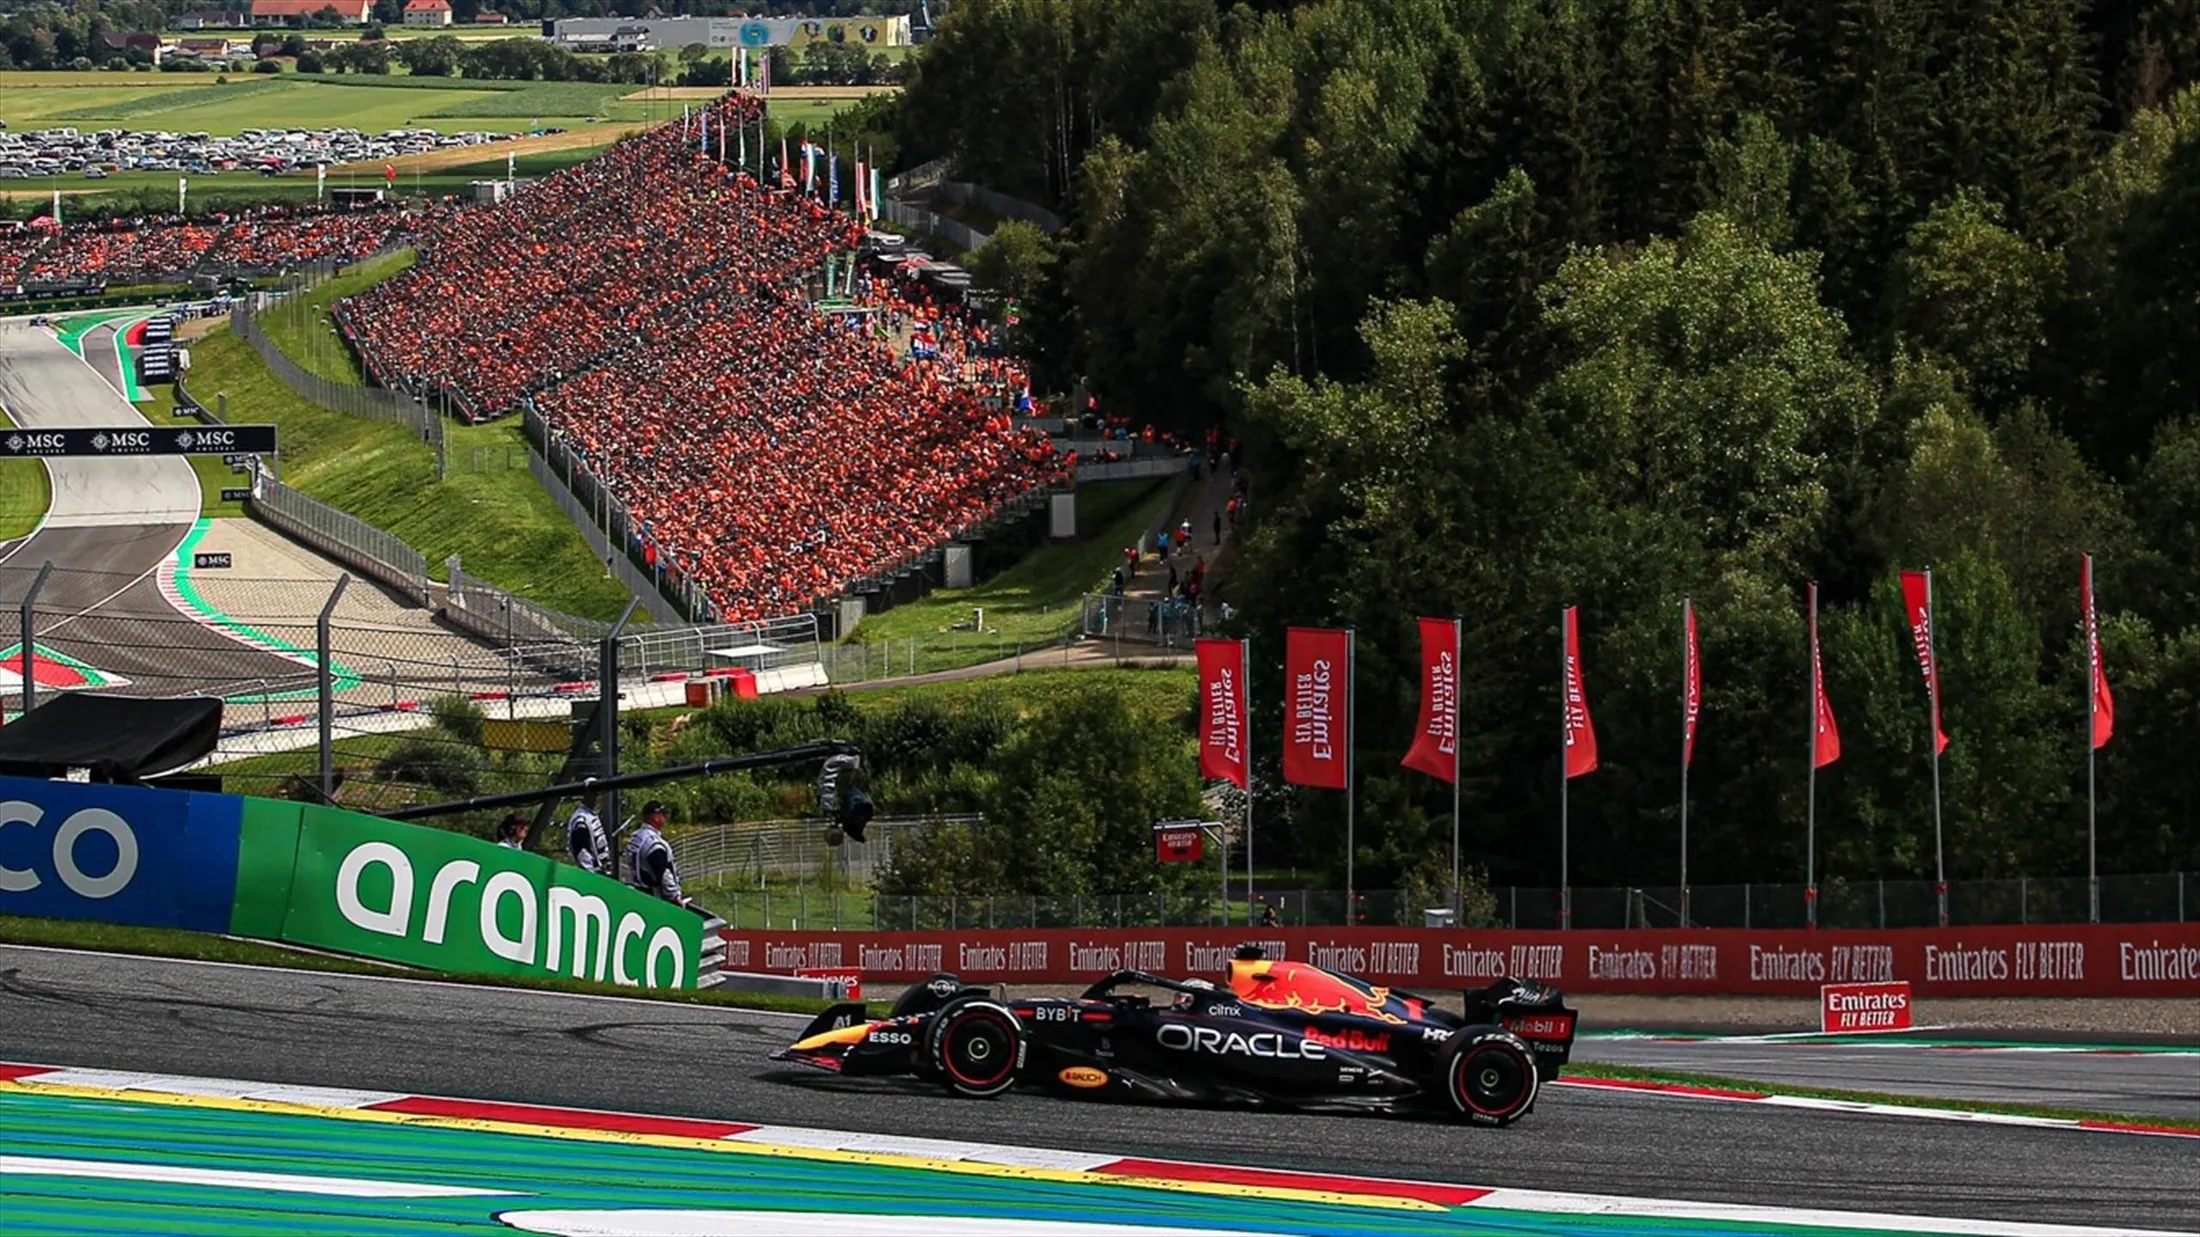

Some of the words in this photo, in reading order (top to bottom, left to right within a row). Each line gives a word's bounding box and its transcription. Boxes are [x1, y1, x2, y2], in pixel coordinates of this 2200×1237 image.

[27, 434, 65, 448] MSC
[111, 432, 150, 446] MSC
[196, 431, 235, 445] MSC
[208, 555, 230, 565] MSC
[1572, 706, 1585, 728] FLY
[336, 841, 684, 989] aramco
[766, 942, 806, 968] Emirates
[859, 944, 902, 971] Emirates
[918, 944, 942, 971] BETTER
[960, 942, 1006, 971] Emirates
[1008, 942, 1020, 971] FLY
[1021, 942, 1047, 971] BETTER
[1070, 941, 1120, 971] Emirates
[1124, 941, 1137, 971] FLY
[1138, 941, 1165, 971] BETTER
[1309, 942, 1366, 973] Emirates
[1370, 942, 1386, 973] FLY
[1387, 942, 1419, 973] BETTER
[1443, 944, 1505, 978] Emirates
[1510, 944, 1526, 978] FLY
[1527, 944, 1563, 978] BETTER
[1589, 945, 1655, 979] Emirates
[1661, 945, 1679, 979] FLY
[1680, 945, 1717, 979] BETTER
[1750, 945, 1825, 981] Emirates
[1831, 945, 1850, 981] FLY
[1851, 945, 1893, 981] BETTER
[1926, 942, 2008, 980] Emirates
[2015, 942, 2036, 980] FLY
[2039, 942, 2084, 980] BETTER
[1036, 1006, 1082, 1021] BYBIT
[1828, 991, 1906, 1012] Emirates
[1511, 1020, 1553, 1033] Mobil
[1560, 1022, 1565, 1033] 1
[1840, 1011, 1858, 1028] FLY
[1859, 1010, 1895, 1027] BETTER
[869, 1032, 912, 1044] ESSO
[1157, 1024, 1327, 1060] ORACLE
[1304, 1026, 1347, 1048] Red
[1349, 1029, 1391, 1052] Bull
